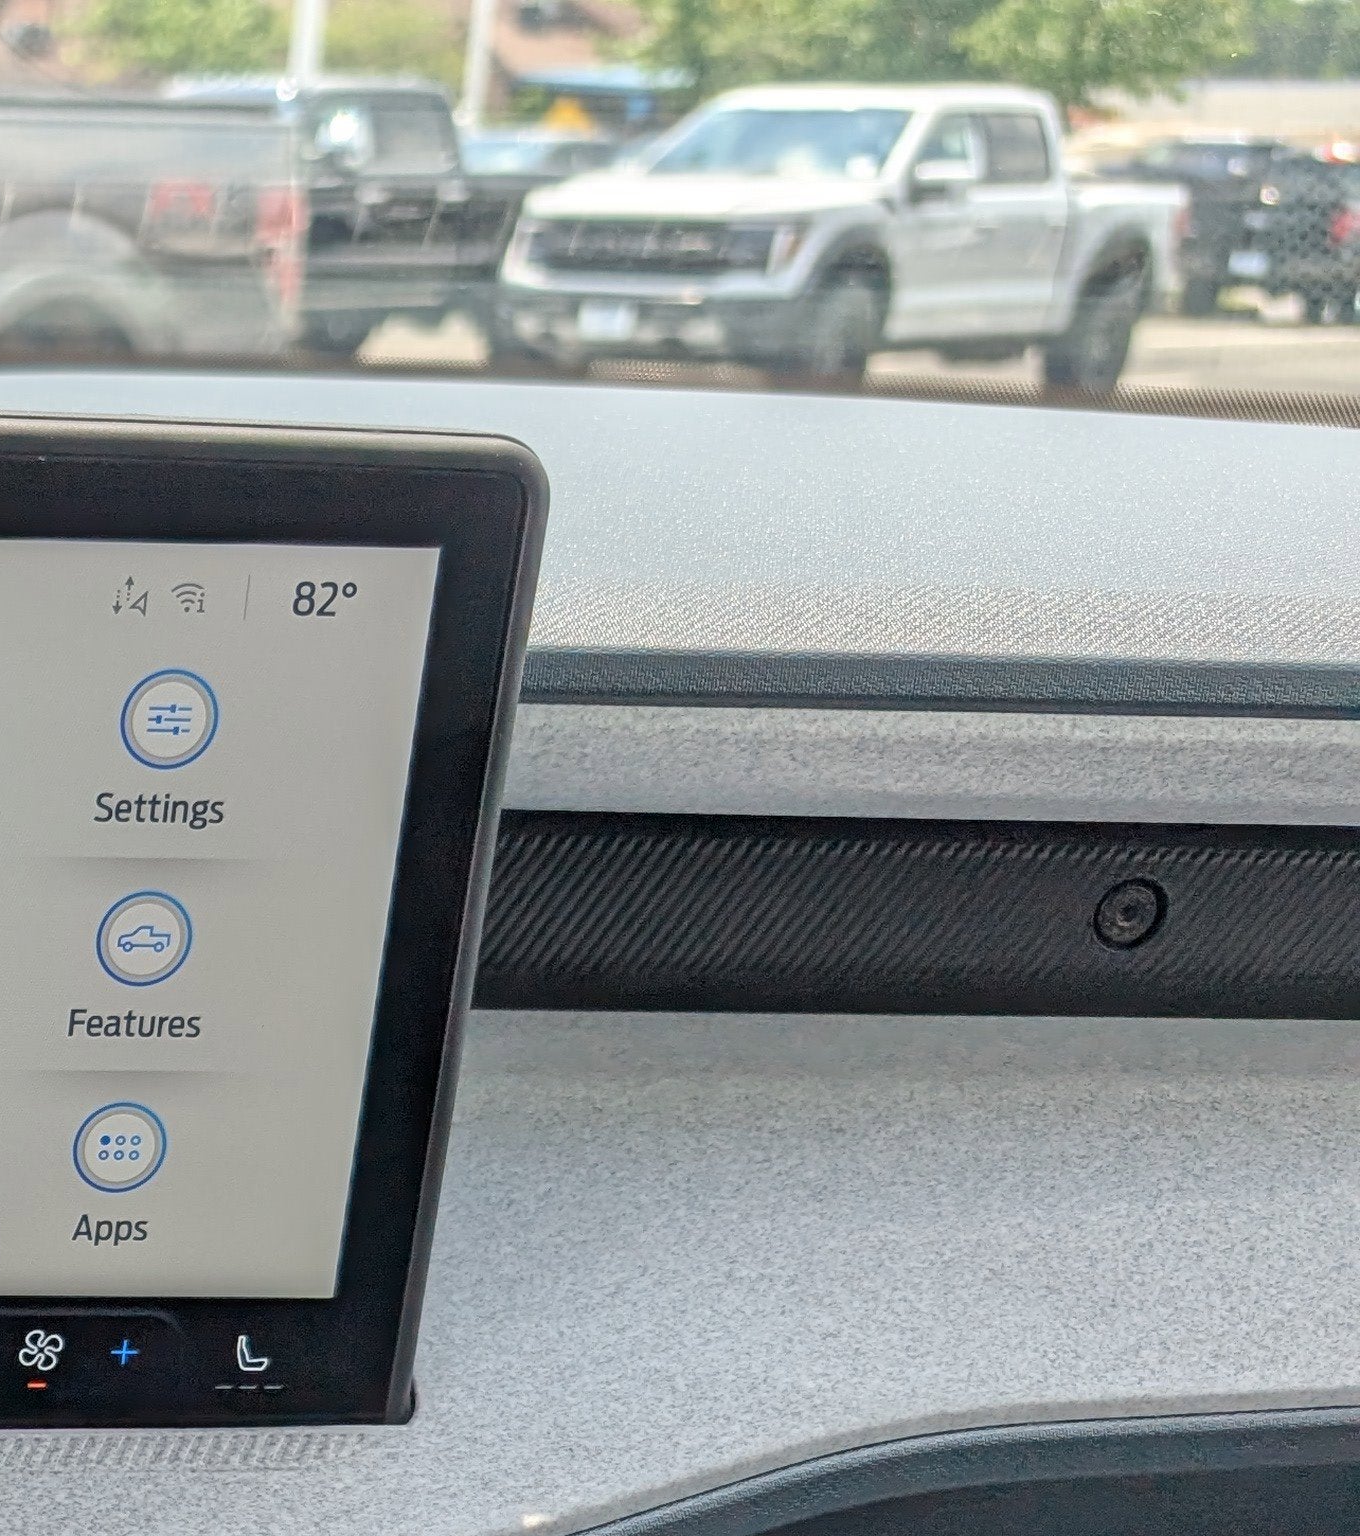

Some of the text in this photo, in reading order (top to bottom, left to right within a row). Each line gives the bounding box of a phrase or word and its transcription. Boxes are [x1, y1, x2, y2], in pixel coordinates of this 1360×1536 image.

[292, 581, 358, 617] 82°
[93, 792, 225, 830] Settings
[68, 1008, 201, 1038] Features
[71, 1213, 148, 1246] Apps
